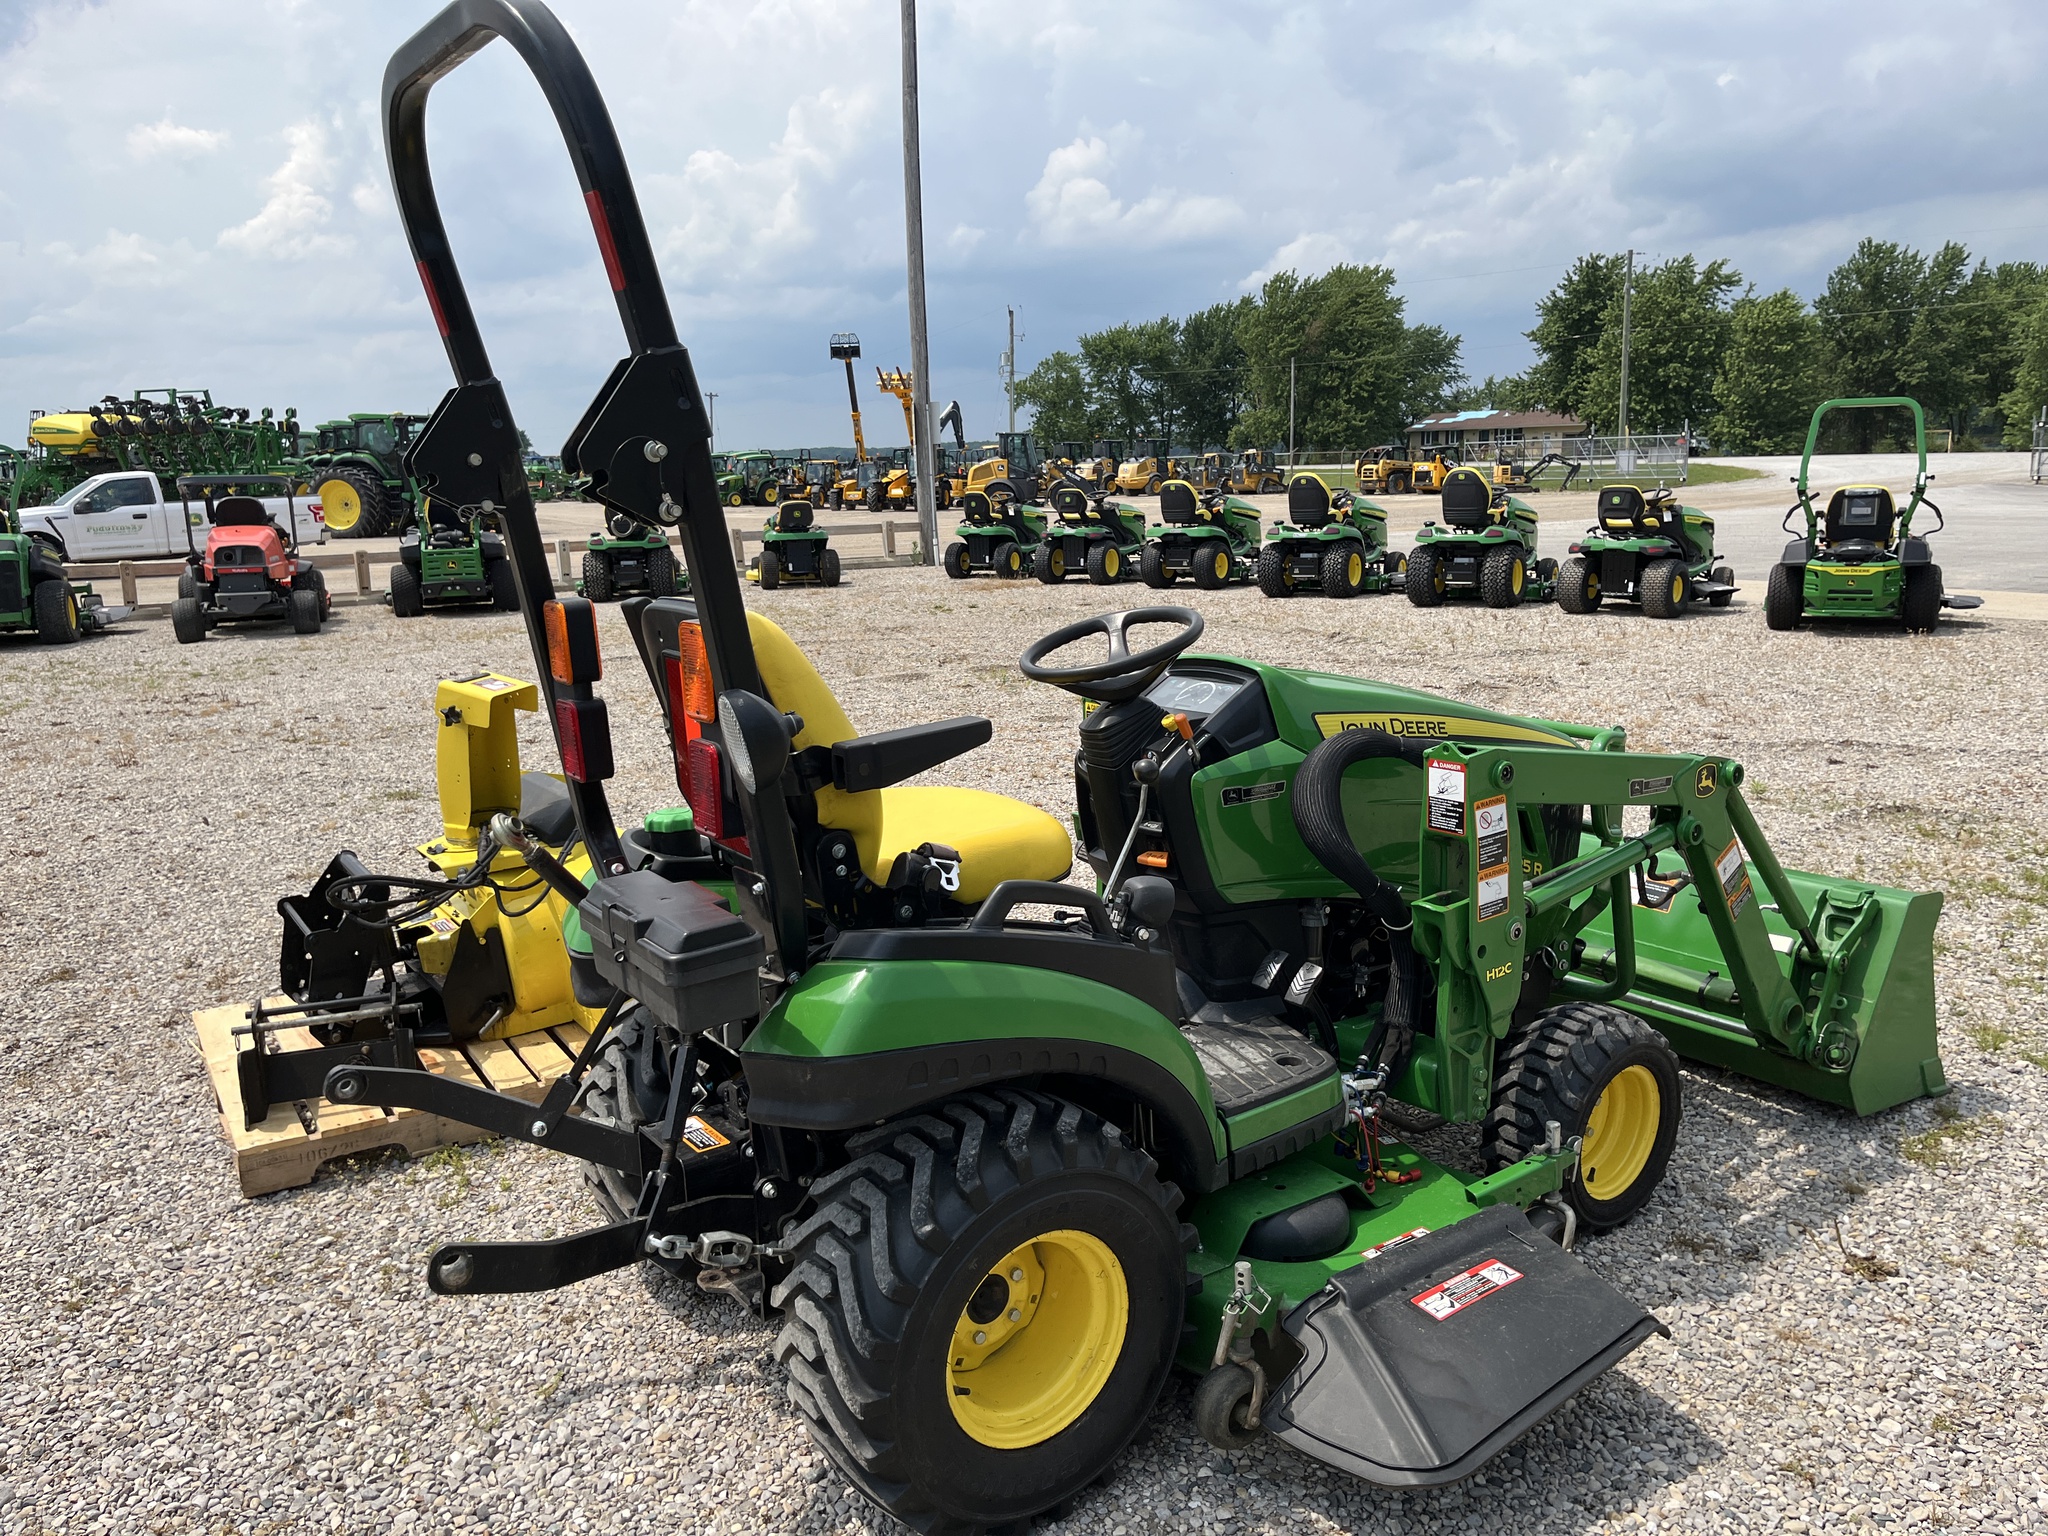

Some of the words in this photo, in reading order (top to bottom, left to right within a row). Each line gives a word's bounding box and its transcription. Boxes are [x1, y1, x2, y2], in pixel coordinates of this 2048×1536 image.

[1389, 718, 1448, 735] DEERE
[1439, 762, 1462, 771] DANGER
[1480, 796, 1505, 808] WARNING
[1483, 866, 1508, 880] WARNING
